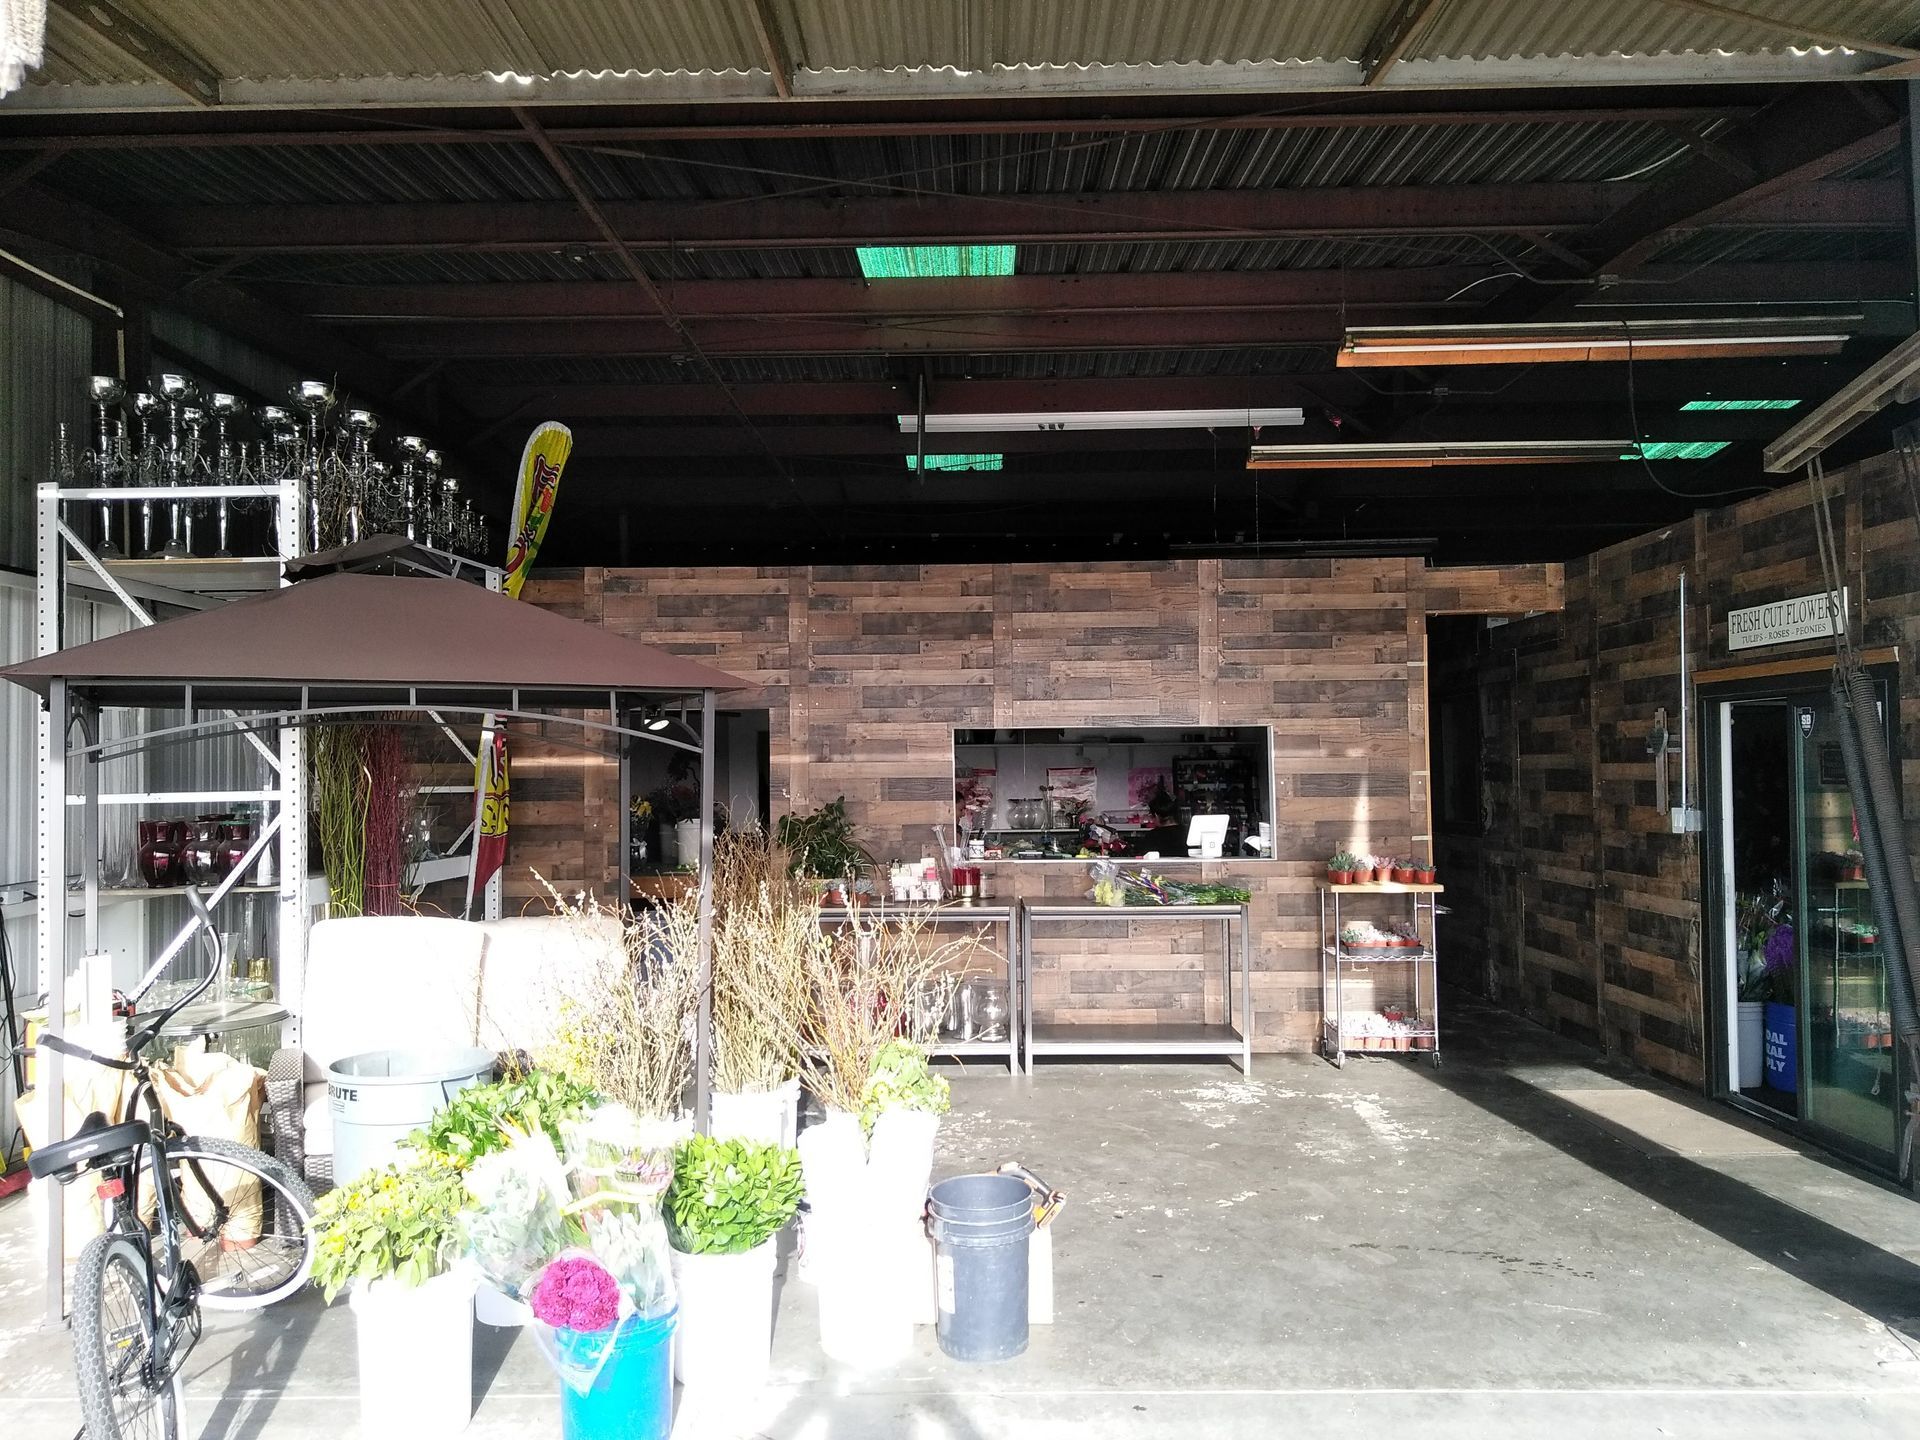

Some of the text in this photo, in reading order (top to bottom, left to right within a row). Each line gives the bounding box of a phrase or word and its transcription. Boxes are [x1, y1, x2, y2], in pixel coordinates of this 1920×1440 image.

[1731, 610, 1761, 634] FRESH
[1763, 605, 1783, 628] CUT
[1742, 633, 1764, 645] TULIPS
[1768, 629, 1790, 640] ROSES
[1795, 624, 1826, 636] PEONIES
[328, 1083, 358, 1102] BRUTE
